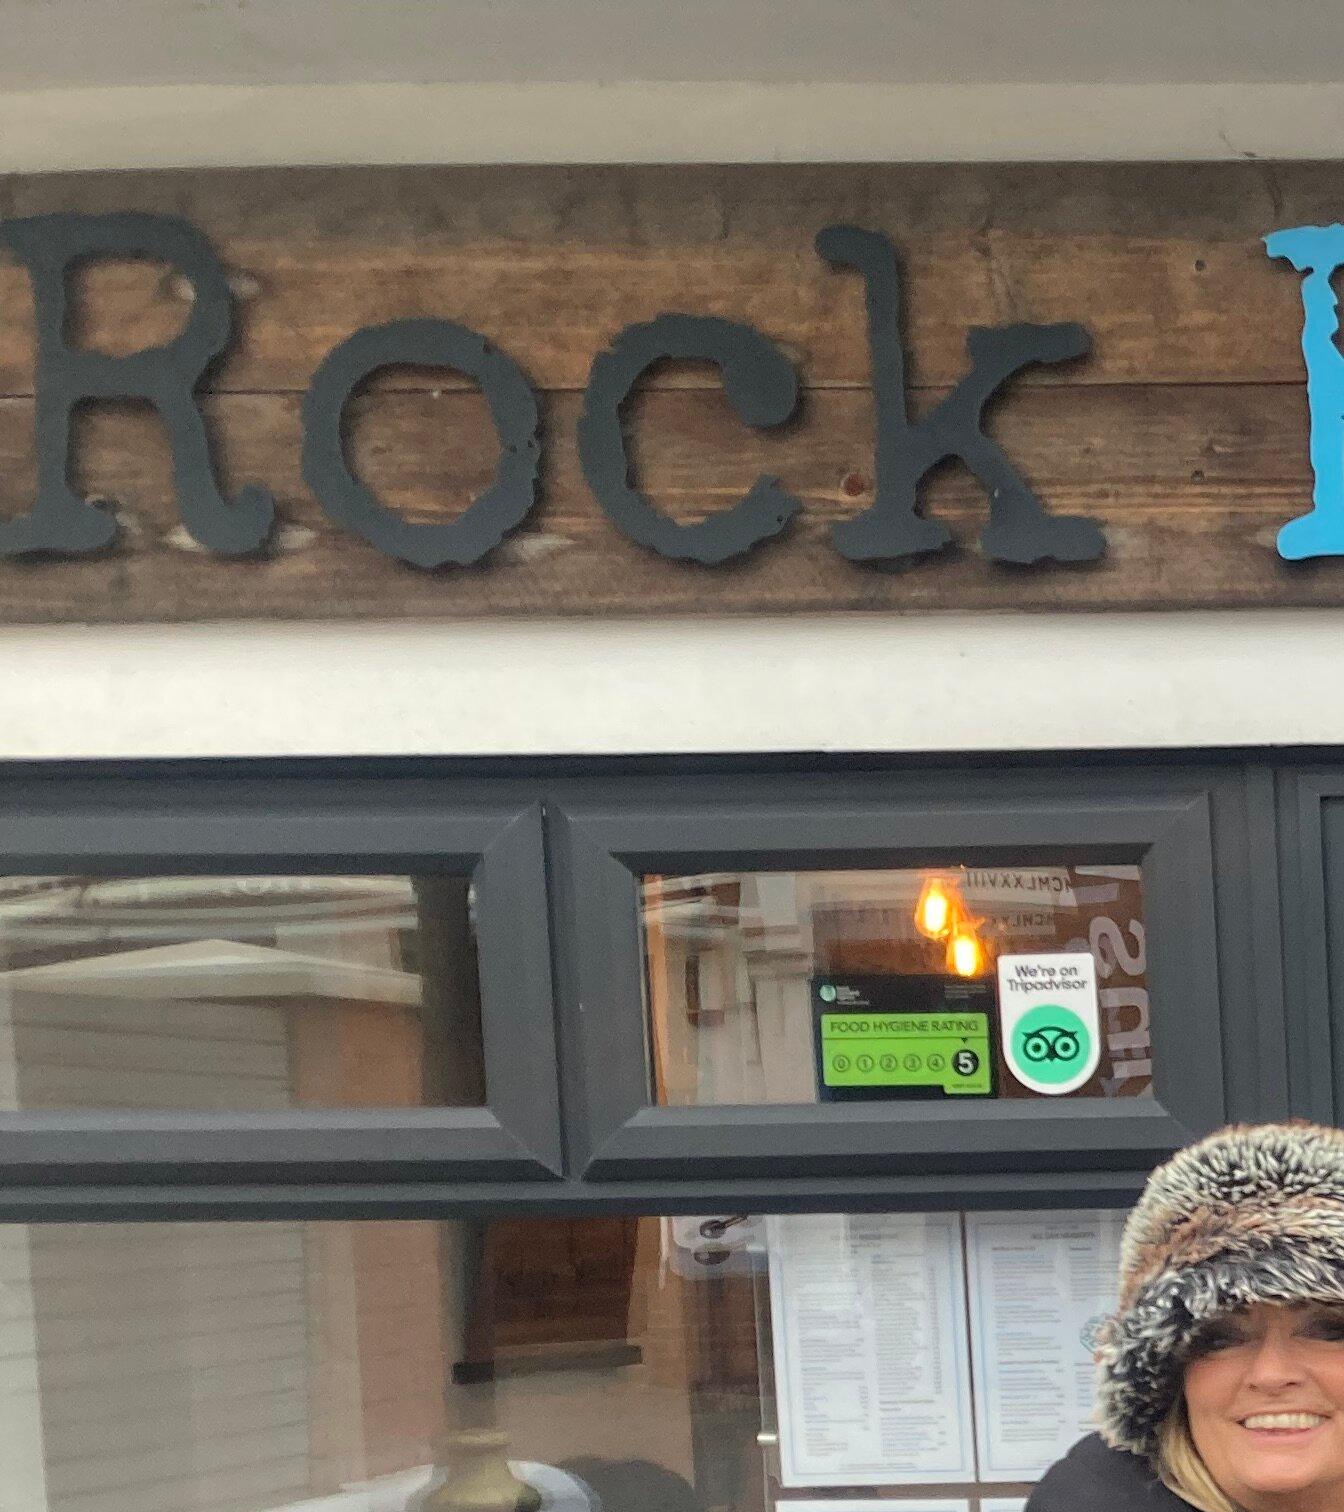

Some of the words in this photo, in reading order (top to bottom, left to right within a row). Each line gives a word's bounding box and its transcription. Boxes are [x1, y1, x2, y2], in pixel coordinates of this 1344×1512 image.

[0, 212, 1107, 568] Rock
[1014, 964, 1056, 977] We're
[1059, 966, 1078, 977] on
[1007, 979, 1088, 994] Tripadvisor
[830, 1022, 870, 1033] FOOD
[872, 1021, 930, 1032] HYGIENE
[931, 1020, 979, 1032] RATING
